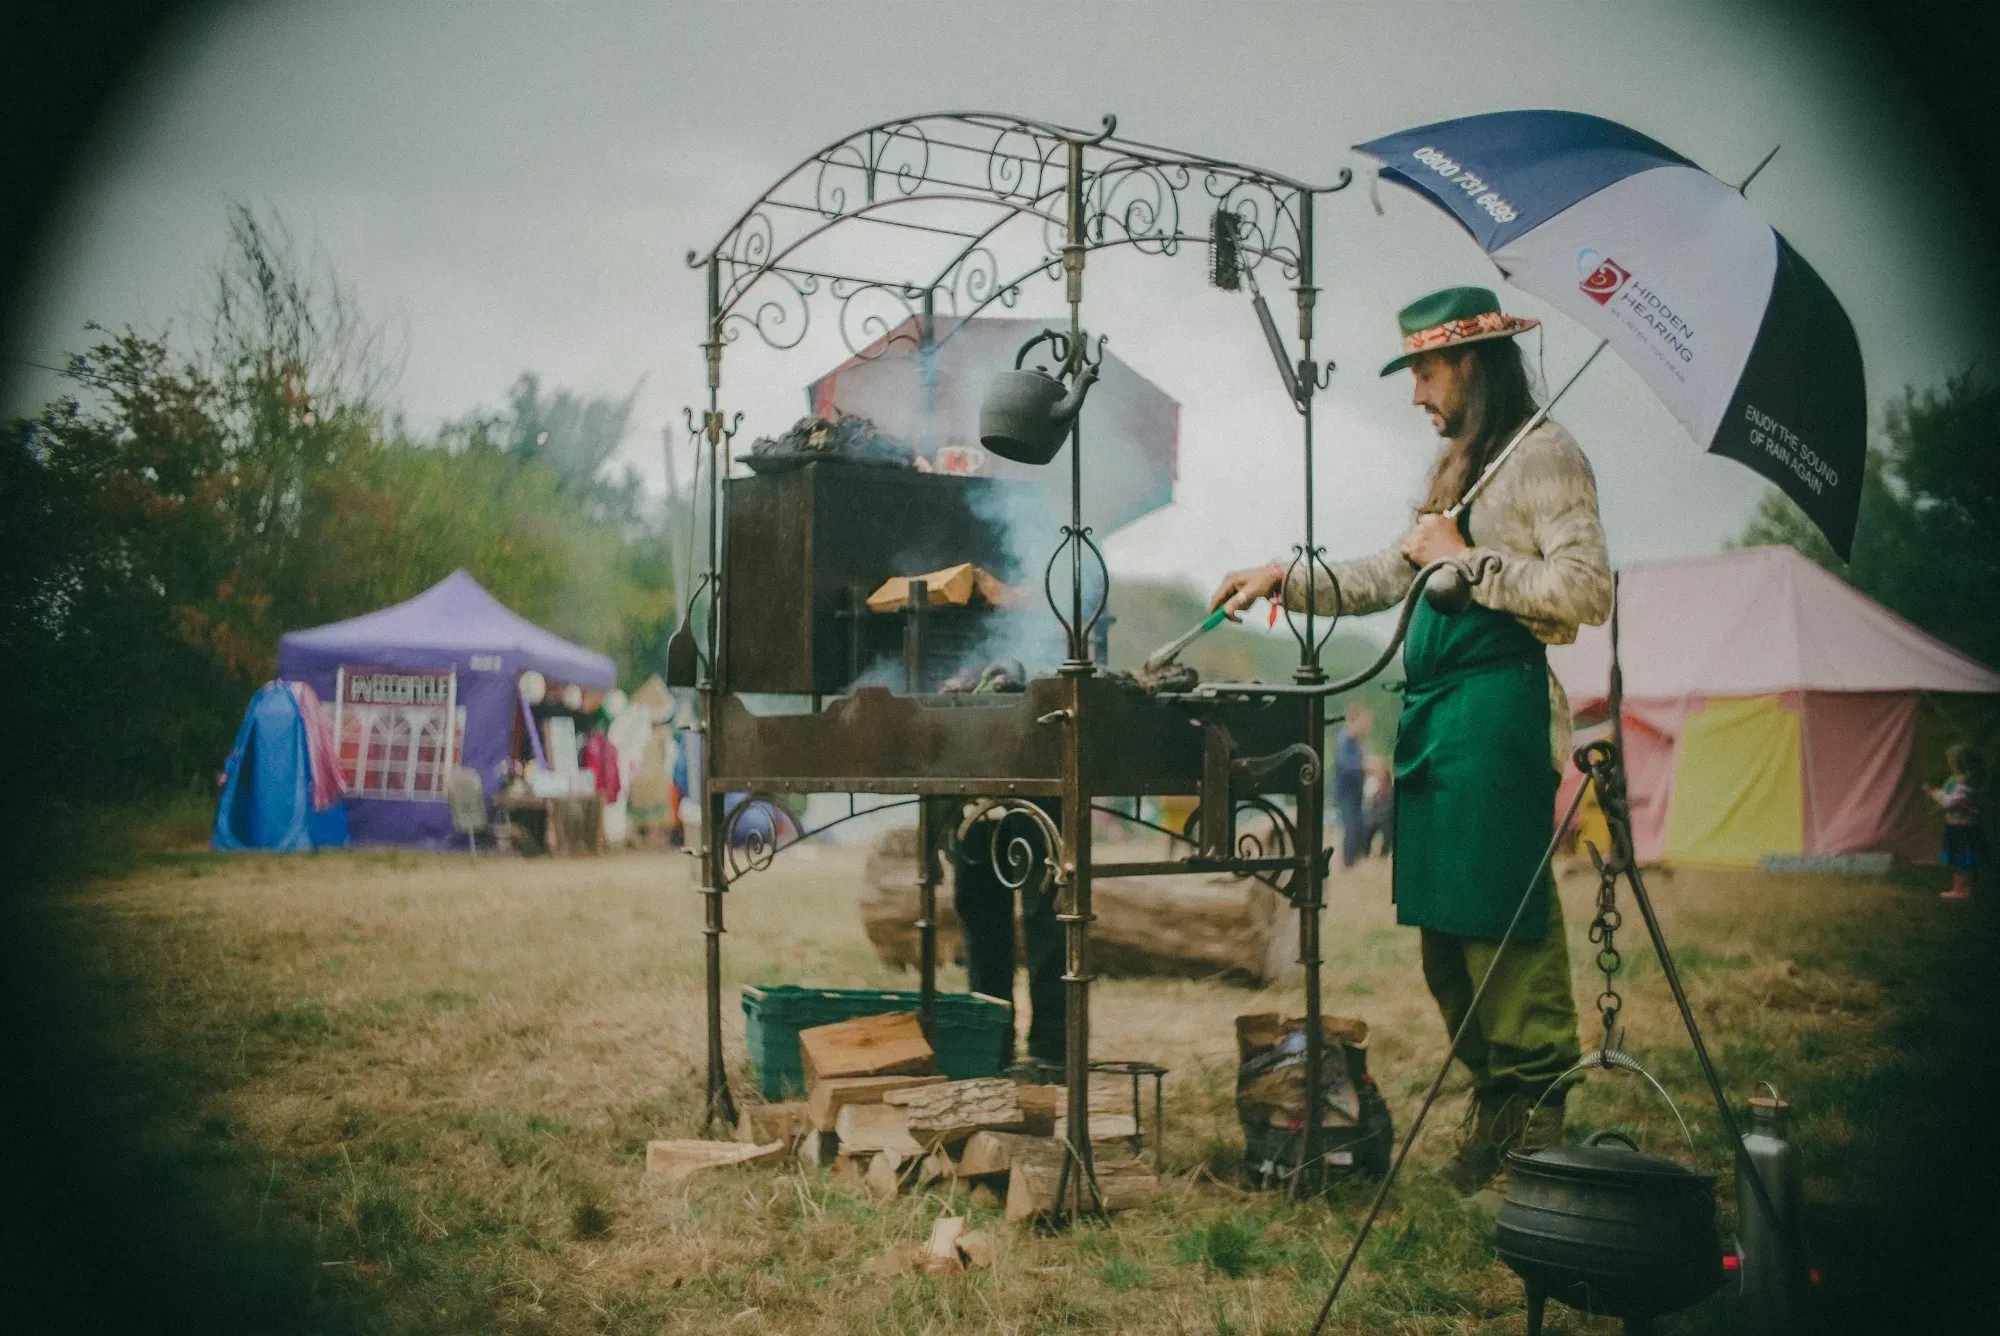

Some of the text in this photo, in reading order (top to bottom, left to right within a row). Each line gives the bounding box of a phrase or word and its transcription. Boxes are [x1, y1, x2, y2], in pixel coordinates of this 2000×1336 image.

[1413, 147, 1461, 177] 0800
[1452, 171, 1488, 196] 731
[1621, 292, 1693, 363] HEARING
[1631, 281, 1694, 339] HIDDEN
[1745, 404, 1838, 487] ENJOY THE SOUND
[1749, 428, 1823, 495] OF RAIN AGAIN
